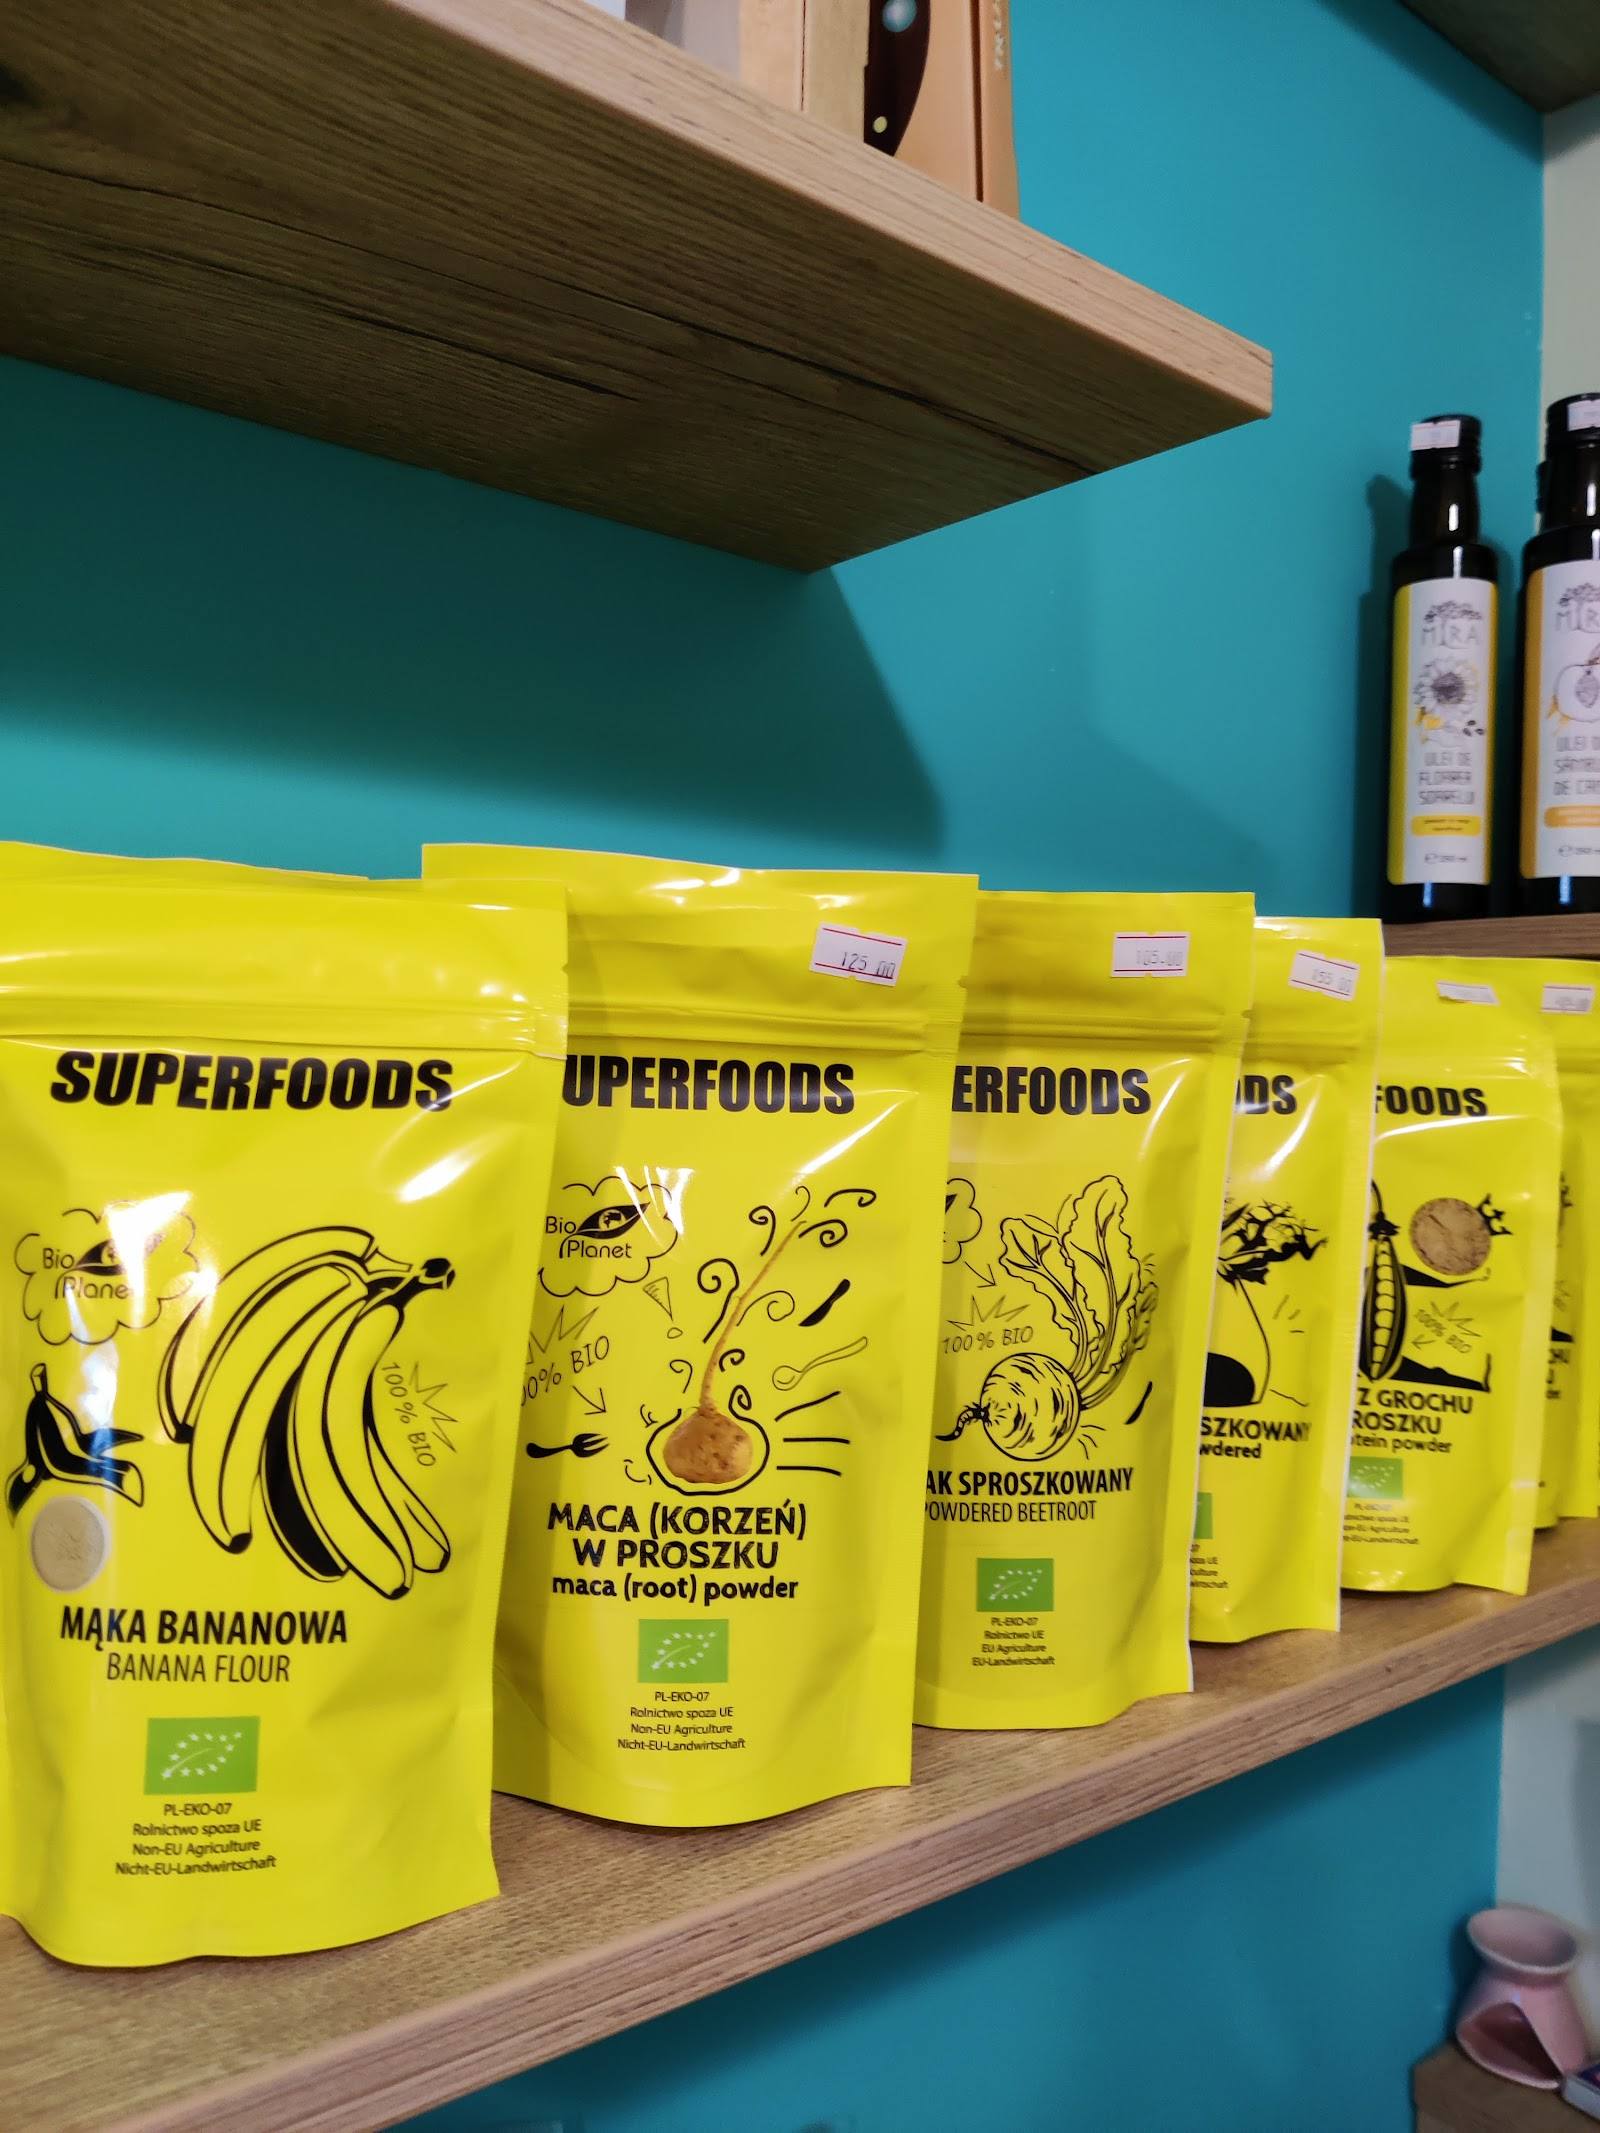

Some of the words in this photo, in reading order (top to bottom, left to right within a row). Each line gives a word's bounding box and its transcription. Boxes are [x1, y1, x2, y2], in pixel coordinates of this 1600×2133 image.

[50, 1050, 453, 1112] SUPERFOODS
[545, 1215, 577, 1234] Bio
[43, 1247, 75, 1269] Bio
[567, 1240, 633, 1259] Planet
[1002, 1325, 1034, 1346] BIO
[570, 1335, 610, 1374] BIO
[1357, 1387, 1371, 1406] Z
[1377, 1389, 1473, 1414] GROCHU
[407, 1432, 436, 1466] BIO
[1392, 1437, 1453, 1453] powder
[958, 1467, 1134, 1497] SPROSZKOWANY
[547, 1502, 640, 1533] MACA
[650, 1498, 807, 1541] (KORZEŃ)
[1018, 1500, 1097, 1523] BEETROOT
[572, 1538, 607, 1568] W
[616, 1539, 780, 1569] PROSZKU
[552, 1576, 618, 1597] maca
[624, 1572, 697, 1603] (root)
[704, 1575, 800, 1607] powder
[60, 1605, 147, 1651] MĄKA
[157, 1609, 348, 1646] BANANOWA
[106, 1652, 206, 1682] BANANA
[214, 1654, 291, 1683] FLOUR
[654, 1691, 710, 1702] PL-EKO-07
[686, 1709, 717, 1720] spoza
[719, 1706, 735, 1717] UE
[630, 1723, 671, 1734] Non-EU
[674, 1724, 733, 1737] Agriculture
[617, 1738, 746, 1751] Nicht-EU-Landwirtschaft
[163, 1802, 233, 1817] PL-EKO-07
[132, 1823, 199, 1836] Rolnictwo
[202, 1822, 241, 1837] spoza
[243, 1818, 262, 1832] UE
[132, 1842, 182, 1856] Non-EU
[185, 1839, 261, 1858] Agriculture
[115, 1854, 277, 1876] Nicht-EU-Landwirtschaft
